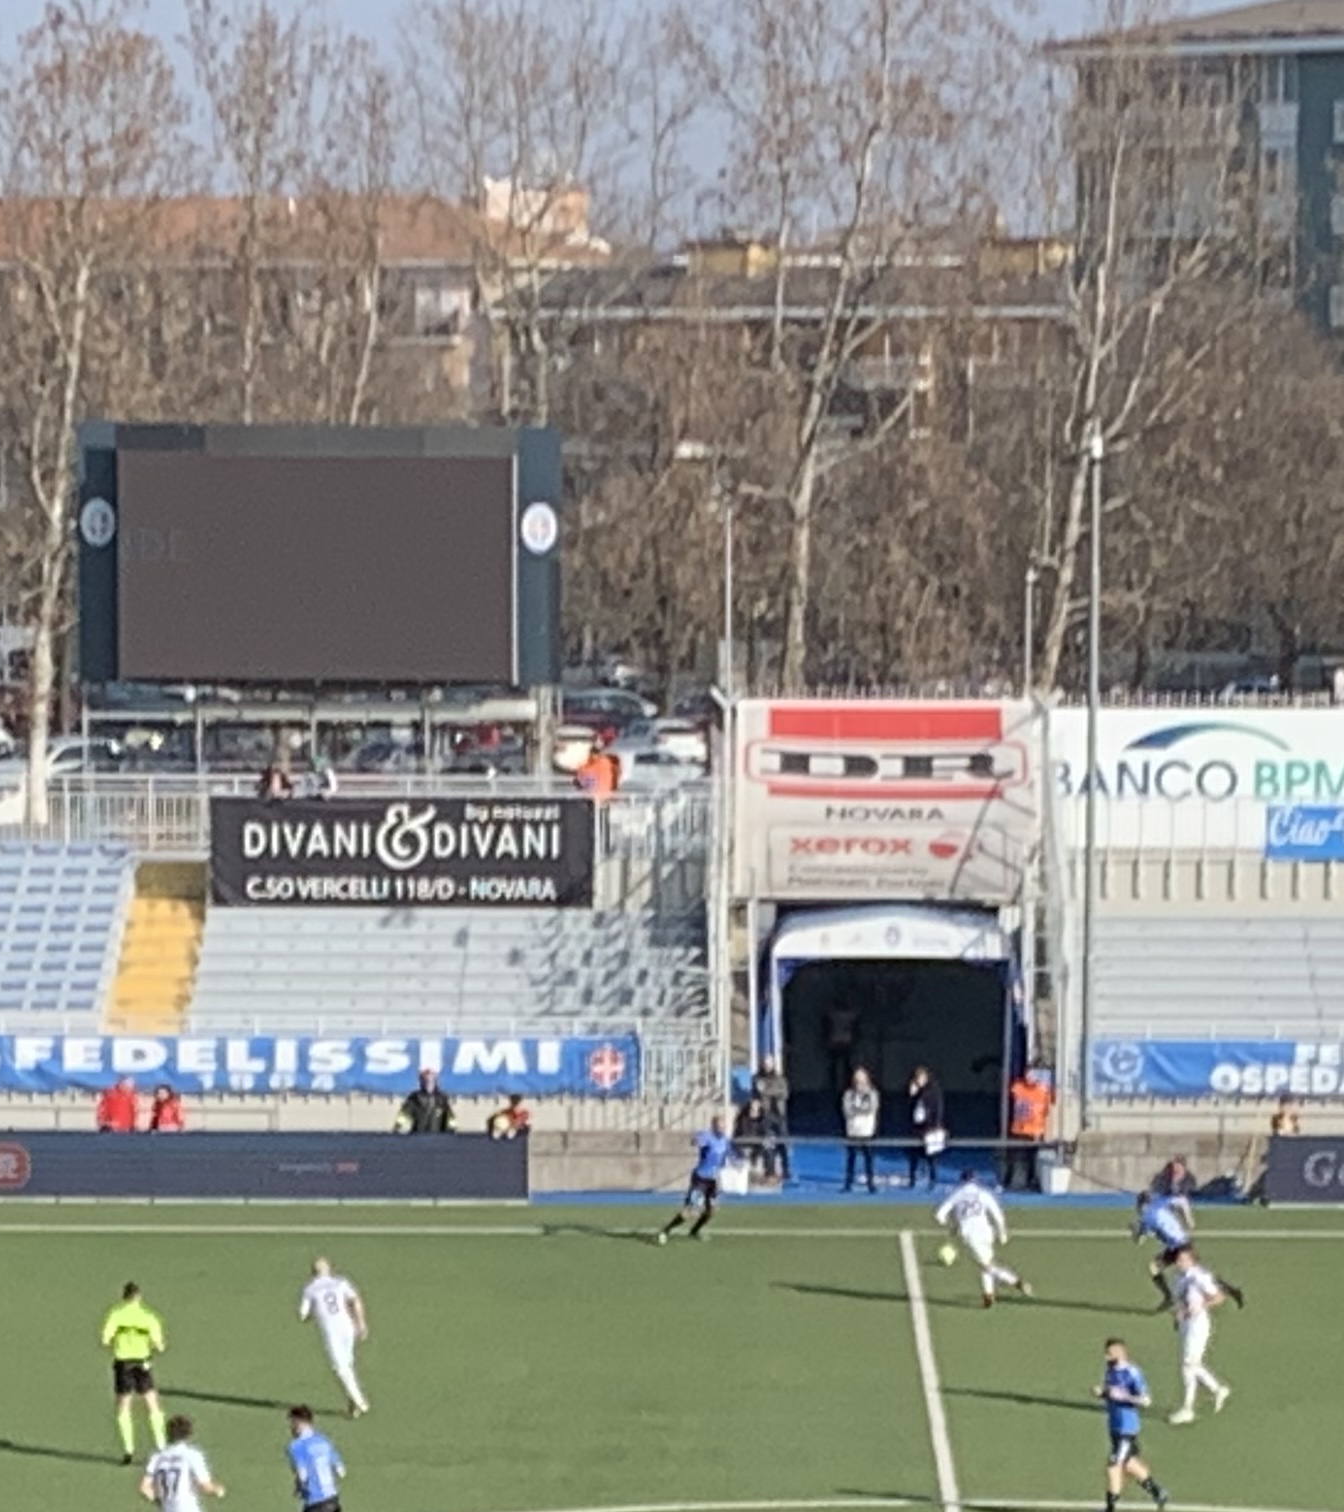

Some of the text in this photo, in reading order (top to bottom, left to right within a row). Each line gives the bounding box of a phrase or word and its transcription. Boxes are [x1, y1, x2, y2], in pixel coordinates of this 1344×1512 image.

[825, 806, 944, 821] NOVARA
[1269, 809, 1340, 847] Ciao
[790, 837, 913, 855] xerox
[293, 878, 390, 900] VERCELLI
[469, 878, 557, 900] NOVARA
[10, 1036, 562, 1074] FEDELISSIMI
